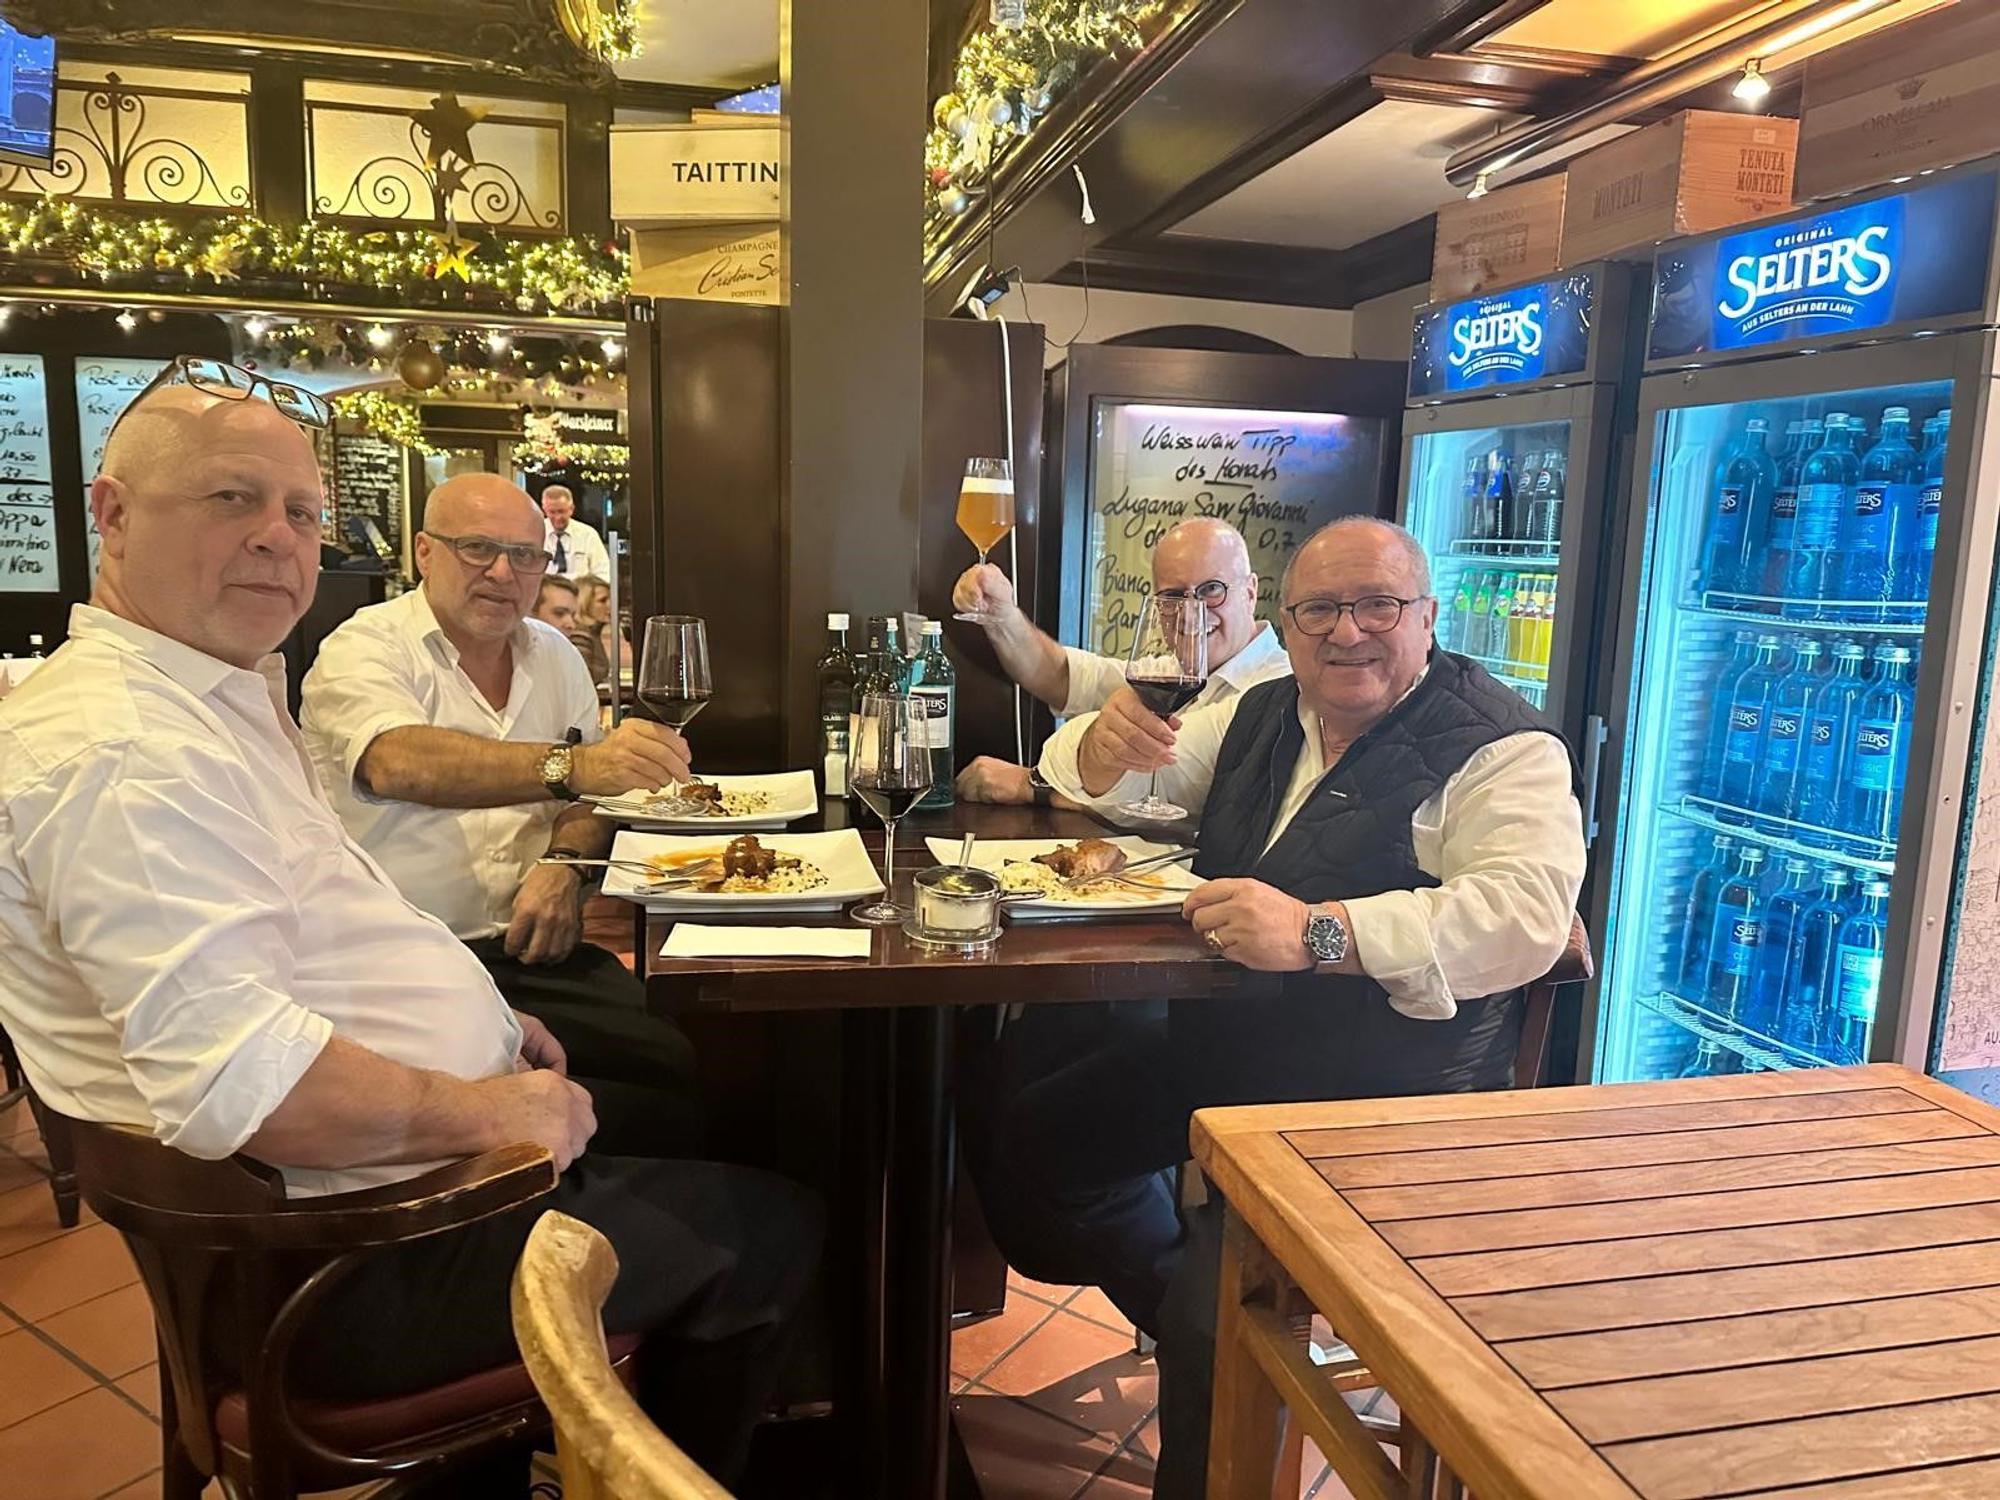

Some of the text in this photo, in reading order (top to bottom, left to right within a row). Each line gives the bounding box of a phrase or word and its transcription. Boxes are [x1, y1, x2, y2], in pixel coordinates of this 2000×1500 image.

[672, 162, 778, 182] TAITTIN
[1739, 149, 1785, 171] TENUTA
[1736, 171, 1784, 195] MONTETI
[1775, 227, 1834, 248] ORIGINAL
[1718, 226, 1891, 319] SELTERS
[1742, 302, 1854, 333] AUS SELTERS AN DER LAHN
[1449, 303, 1542, 366] SELTERS
[1175, 456, 1278, 482] des Monats
[1102, 486, 1189, 538] Lugana
[1238, 492, 1313, 538] Giovanni
[1096, 554, 1151, 597] Bianco
